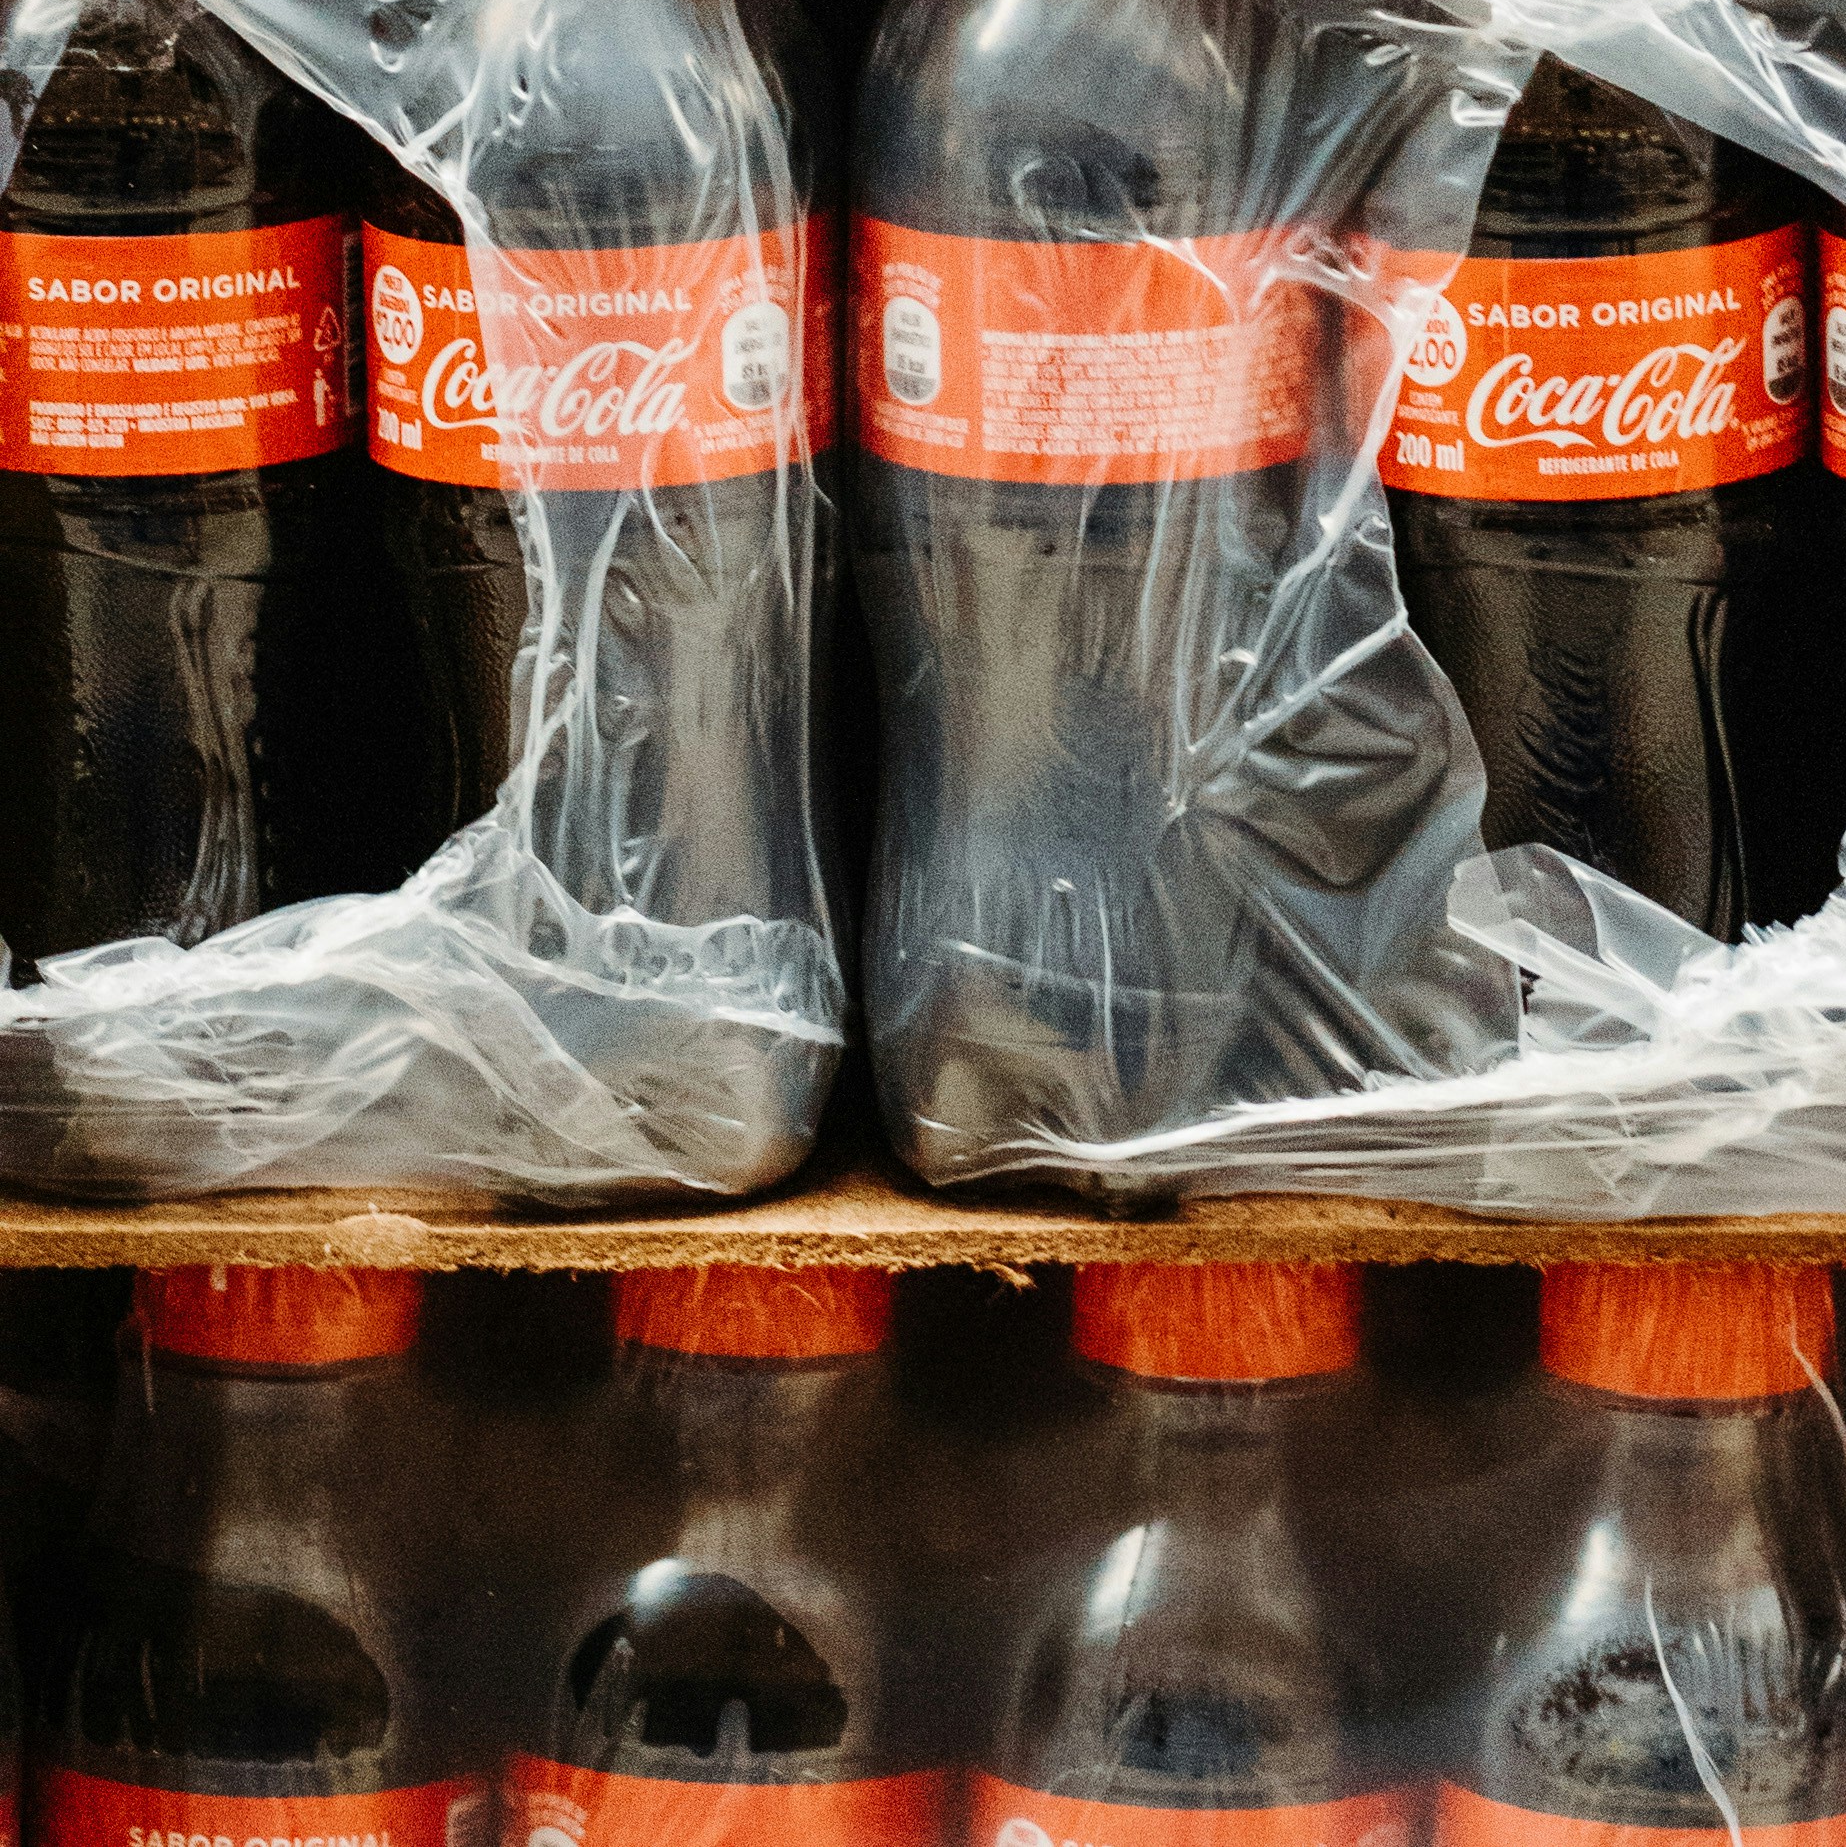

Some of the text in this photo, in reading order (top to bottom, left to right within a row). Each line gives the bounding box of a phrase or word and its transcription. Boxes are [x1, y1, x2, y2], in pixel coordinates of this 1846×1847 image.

[28, 266, 300, 304] SABOR ORIGINAL
[422, 284, 693, 319] SABOR ORIGINAL
[1468, 287, 1742, 329] SABOR ORIGINAL
[422, 337, 700, 438] Coca-Cola
[1465, 336, 1748, 448] Coca-Cola
[1435, 439, 1465, 473] ml
[1631, 452, 1647, 471] DE
